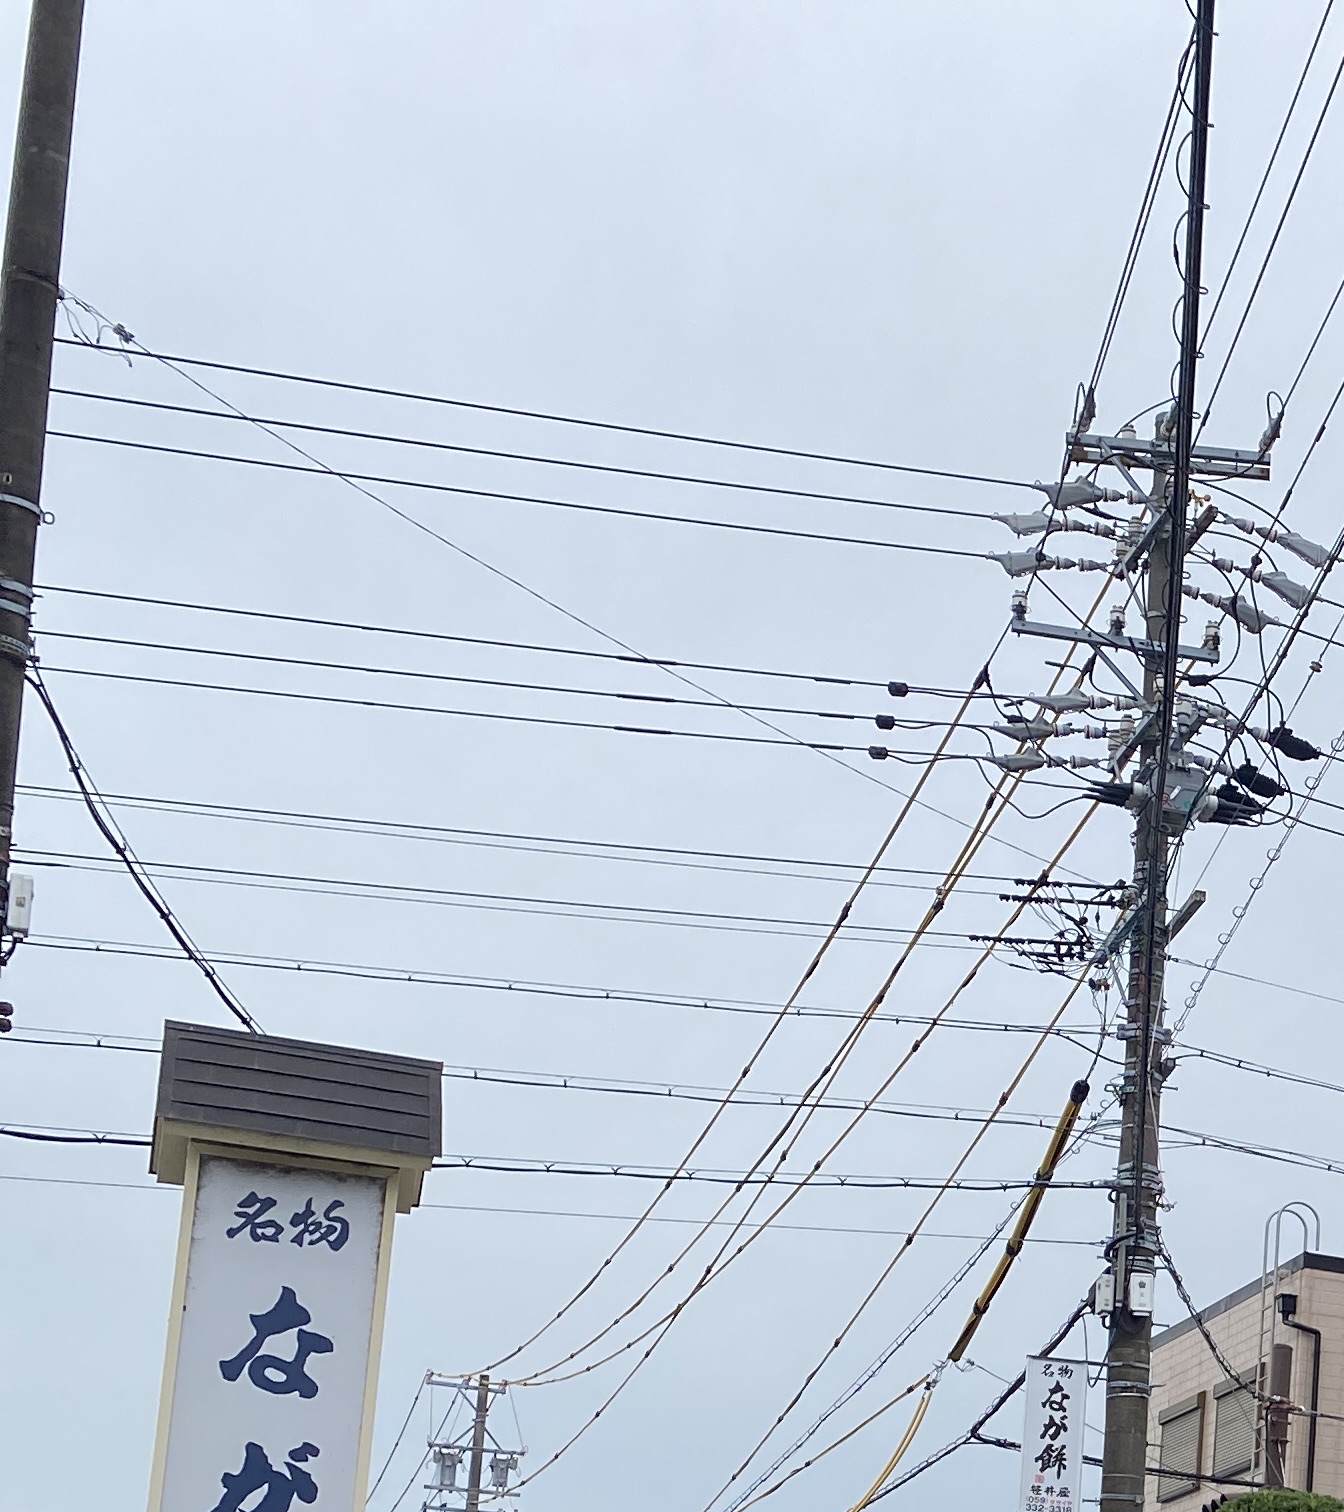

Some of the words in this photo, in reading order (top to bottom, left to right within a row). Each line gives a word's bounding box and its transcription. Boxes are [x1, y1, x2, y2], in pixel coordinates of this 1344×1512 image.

[226, 1190, 350, 1252] 名物
[1041, 1363, 1074, 1380] 名物
[1034, 1380, 1071, 1480] なが餅
